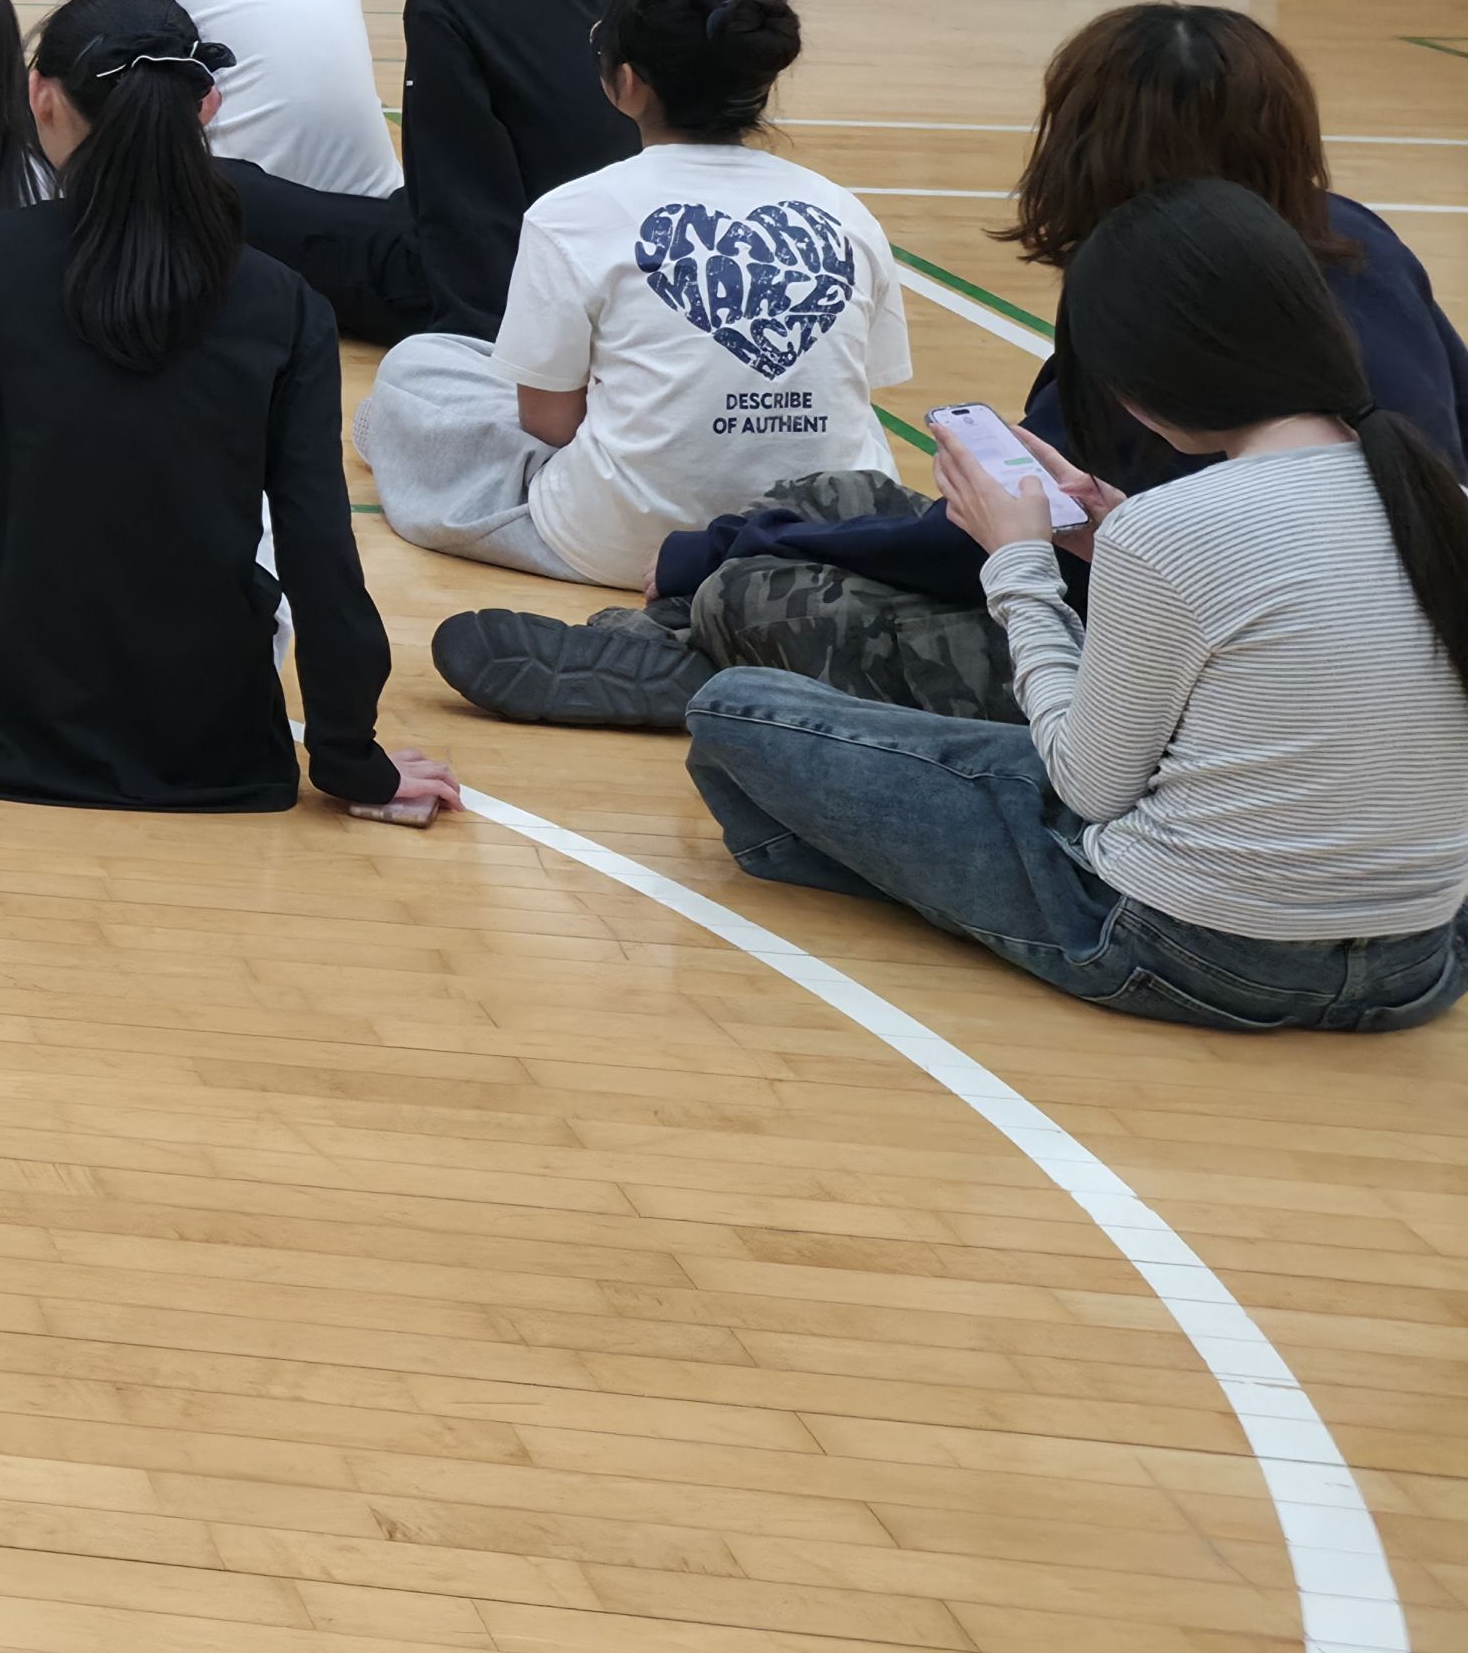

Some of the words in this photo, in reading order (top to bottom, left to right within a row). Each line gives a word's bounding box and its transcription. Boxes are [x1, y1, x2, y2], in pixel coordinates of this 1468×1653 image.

[646, 255, 853, 334] MAKE
[726, 392, 812, 410] DESCRIBE
[712, 417, 738, 435] OF
[741, 415, 828, 434] AUTHENT
